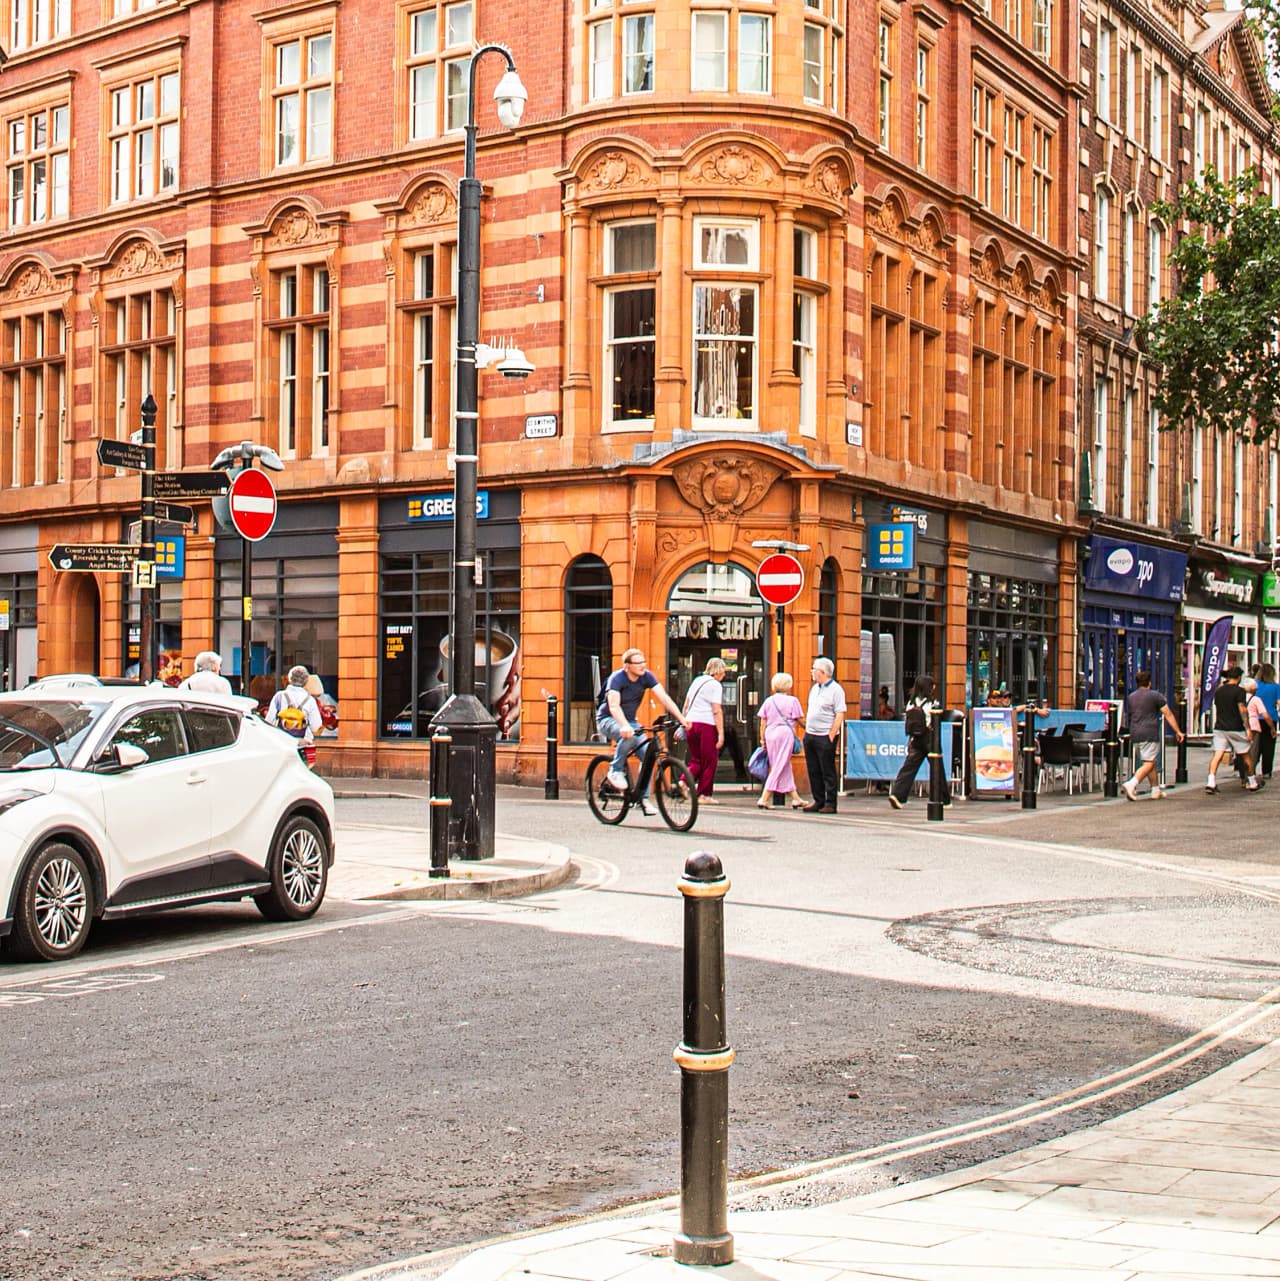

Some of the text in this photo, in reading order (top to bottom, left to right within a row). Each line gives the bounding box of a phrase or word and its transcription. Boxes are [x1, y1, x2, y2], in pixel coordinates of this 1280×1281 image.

[423, 496, 483, 516] GRES
[1205, 646, 1219, 691] evapo
[879, 744, 908, 756] GRE
